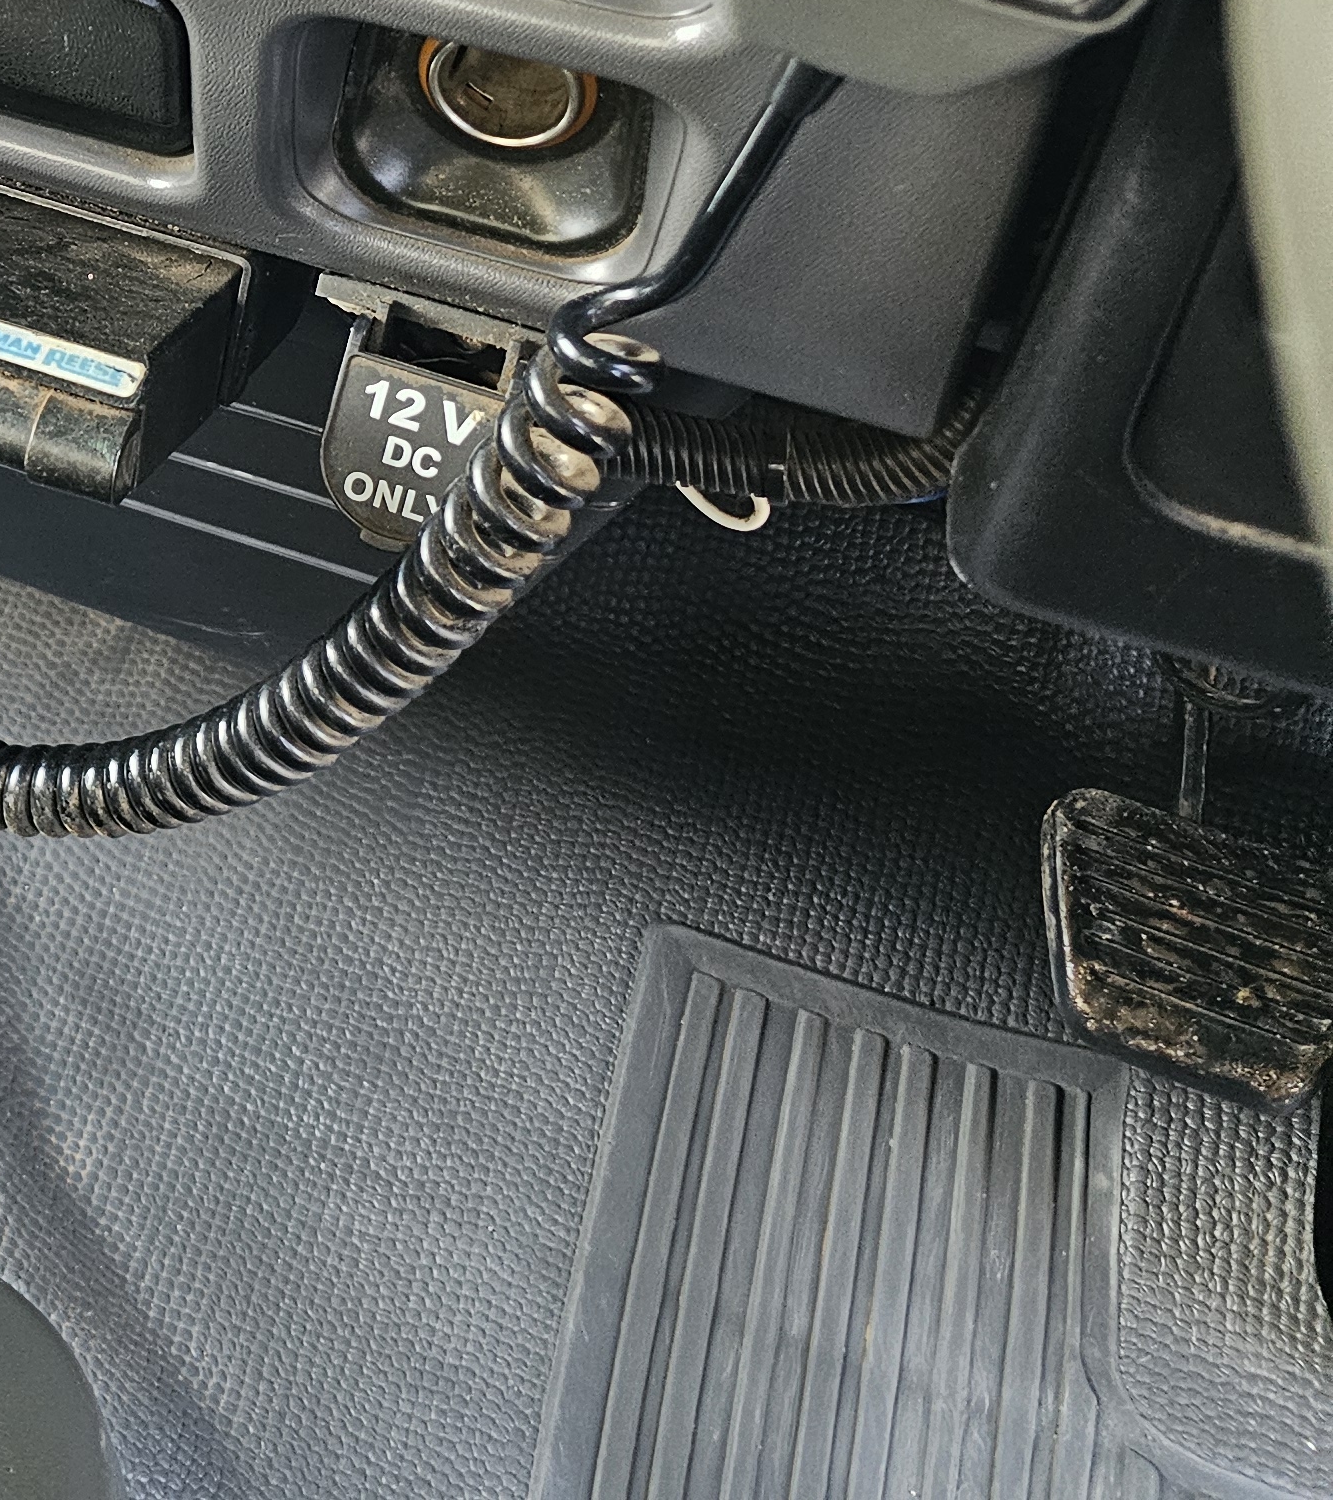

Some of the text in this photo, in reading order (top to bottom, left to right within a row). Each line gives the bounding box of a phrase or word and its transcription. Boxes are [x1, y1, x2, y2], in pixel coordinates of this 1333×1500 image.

[364, 379, 486, 446] 12 V
[381, 434, 443, 479] DC
